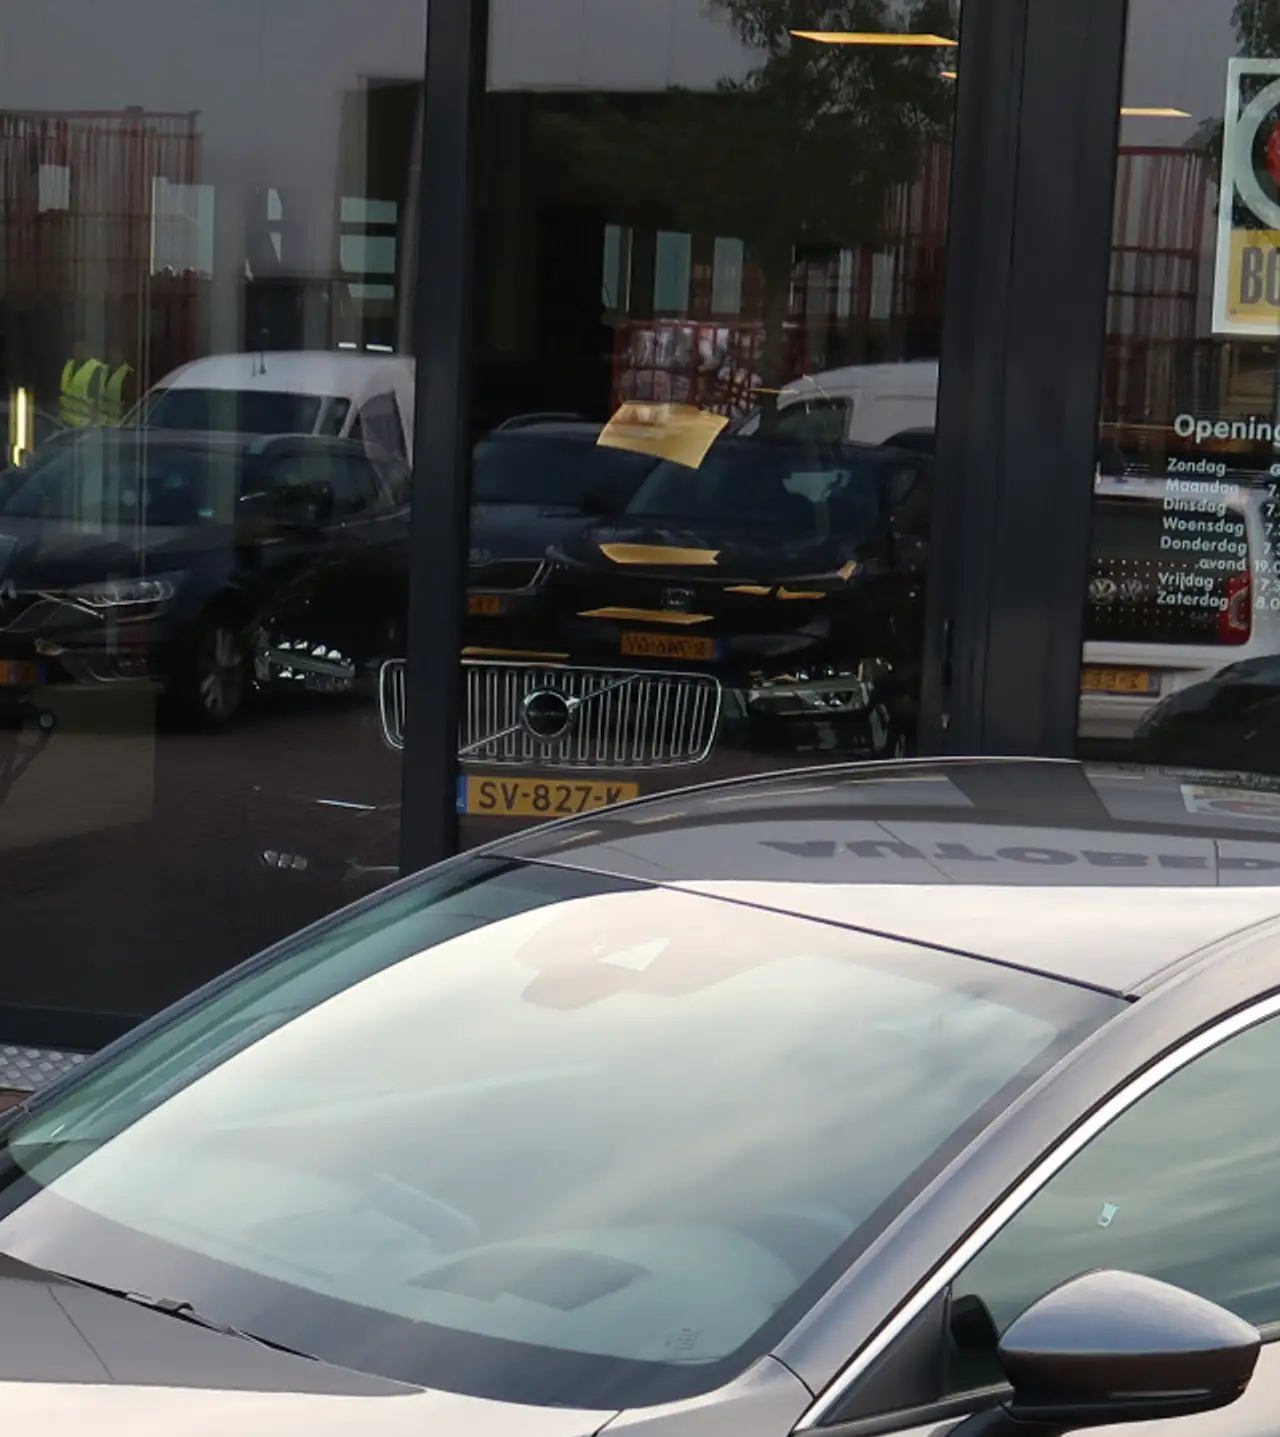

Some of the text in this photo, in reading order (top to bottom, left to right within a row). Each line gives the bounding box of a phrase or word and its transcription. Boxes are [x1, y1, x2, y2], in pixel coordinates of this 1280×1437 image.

[1167, 457, 1226, 477] Zondag
[1166, 479, 1240, 496] Maandag
[1163, 499, 1227, 516] Dinsdag
[1162, 517, 1244, 536] Woensdag
[1160, 536, 1248, 556] Donderdag
[1158, 572, 1214, 591] Vrijdag
[1156, 591, 1229, 611] Zaterdag
